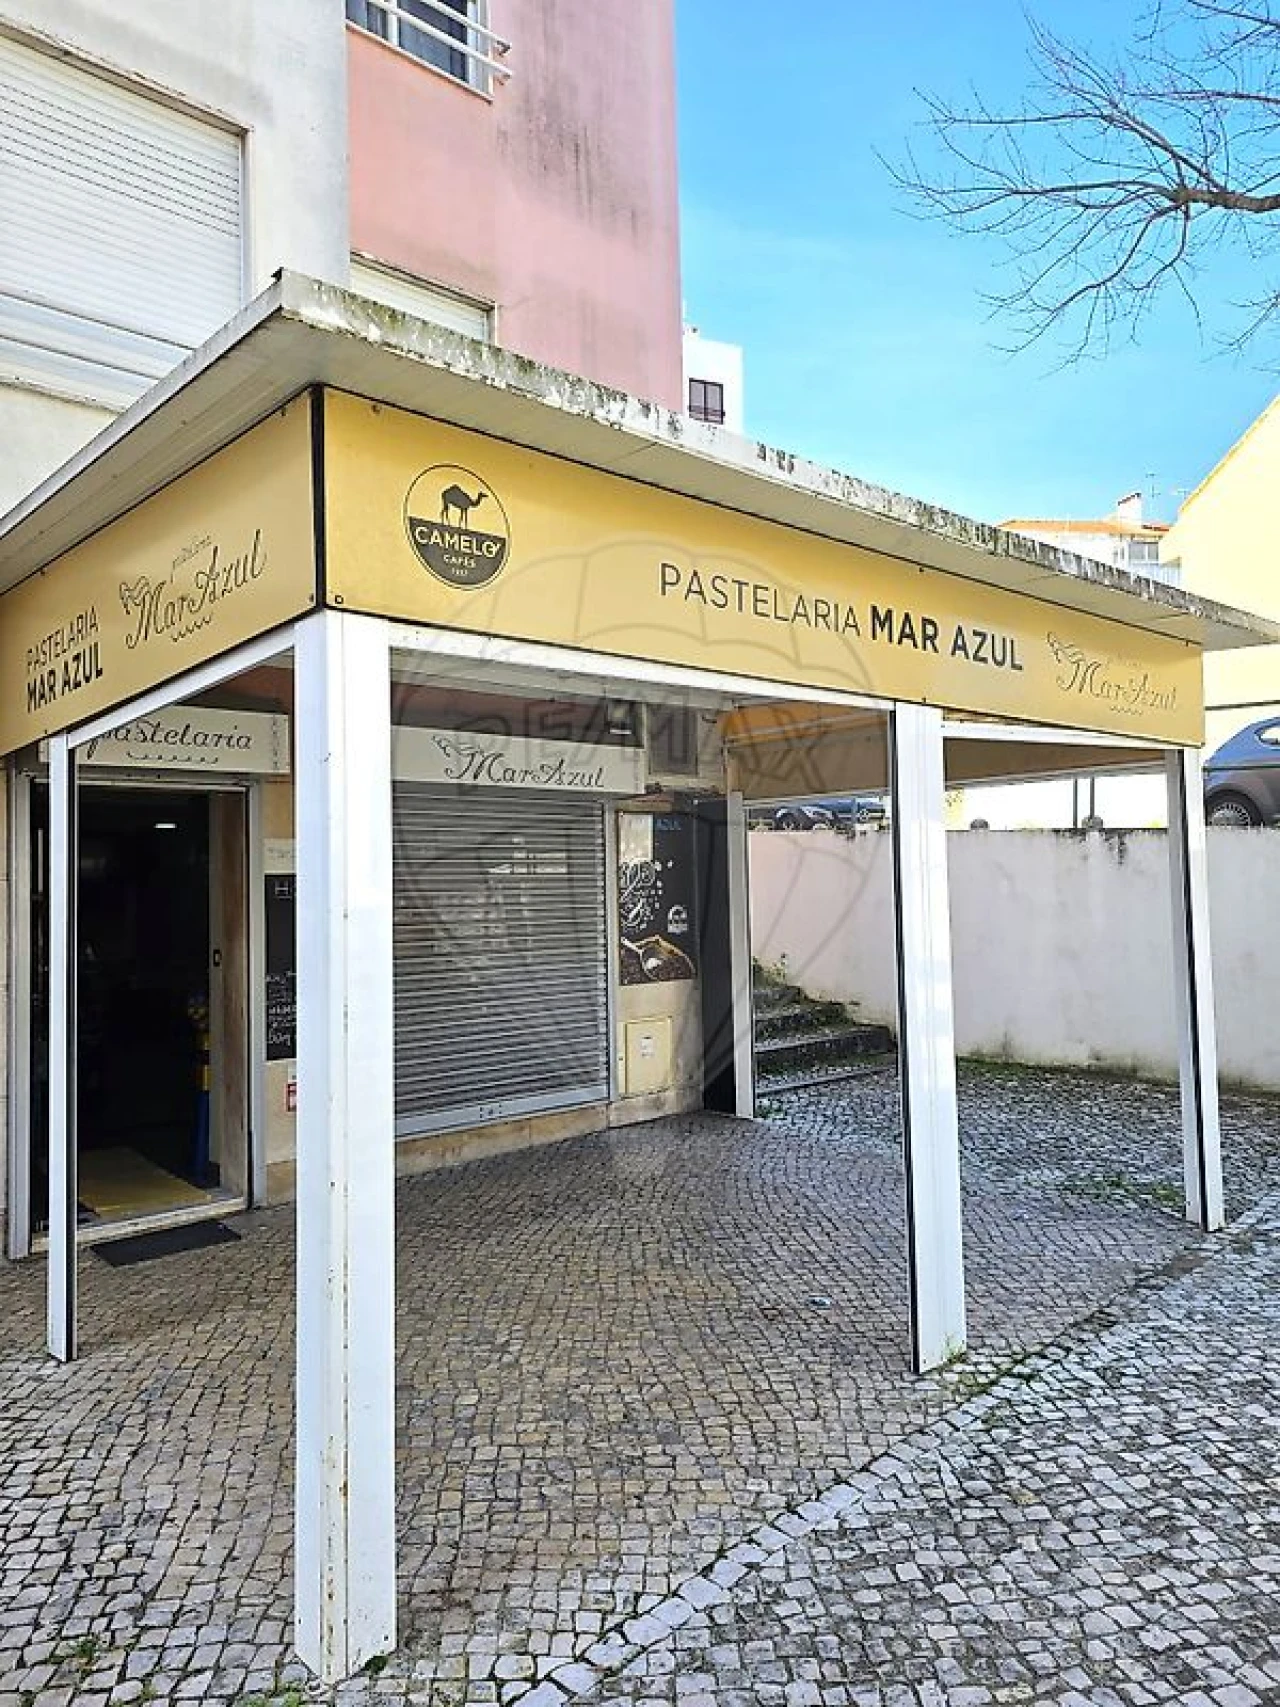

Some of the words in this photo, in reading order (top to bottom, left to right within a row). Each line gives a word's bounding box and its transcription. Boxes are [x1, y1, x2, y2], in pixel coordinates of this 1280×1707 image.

[415, 527, 500, 558] CAMELO
[27, 606, 99, 674] PASTELARIA
[659, 562, 861, 636] PASTELARIA
[870, 604, 940, 654] MAR
[951, 624, 1024, 672] AZUL
[27, 668, 56, 714] MAR
[61, 641, 103, 697] AZUL
